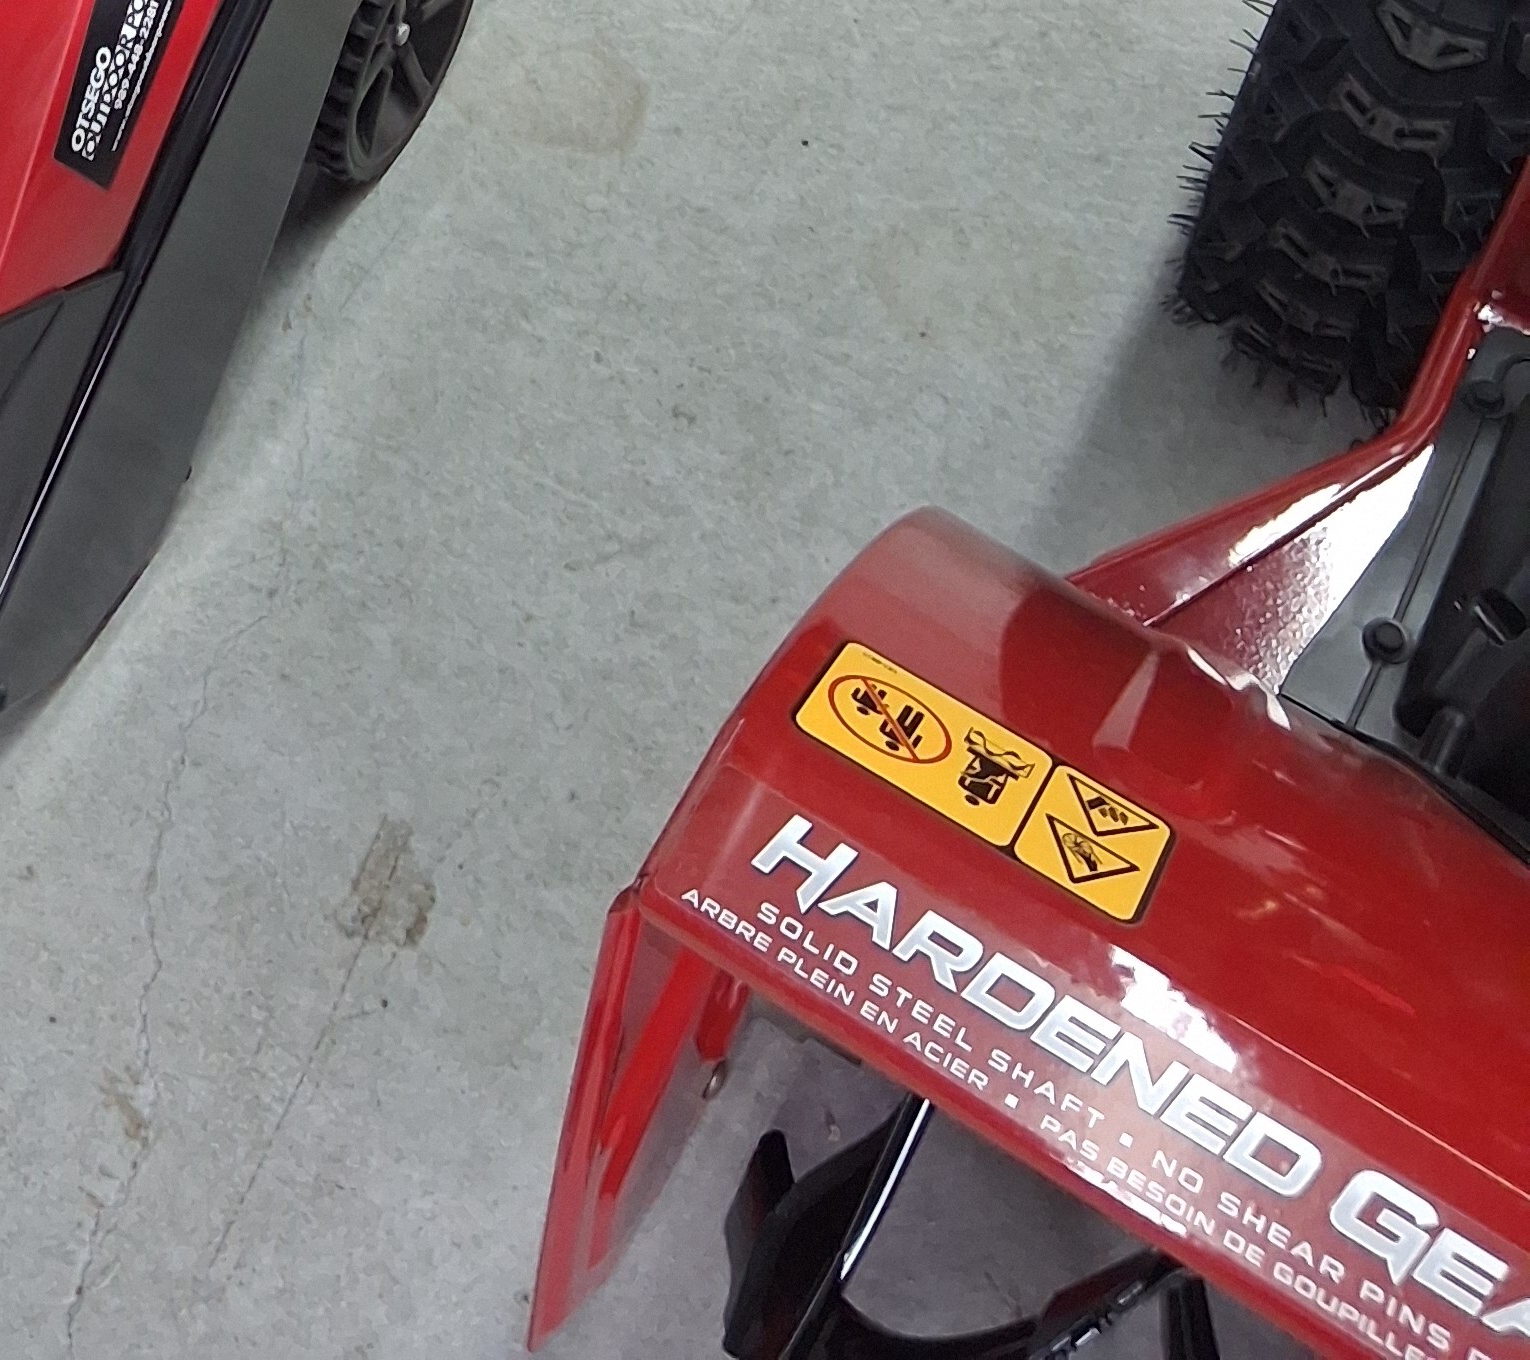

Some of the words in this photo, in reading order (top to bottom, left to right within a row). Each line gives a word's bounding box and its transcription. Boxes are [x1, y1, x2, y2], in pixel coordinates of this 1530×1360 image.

[71, 46, 112, 152] OTSEGO
[82, 31, 136, 161] OUTDOOR
[681, 888, 773, 953] ARBRE
[777, 947, 855, 1006] PLEIN
[860, 1000, 898, 1033] EN
[903, 1032, 989, 1091] ACIER
[1040, 1115, 1100, 1161] PAS
[1107, 1156, 1216, 1236] BESOIN
[1223, 1230, 1265, 1268] DE
[1273, 1261, 1436, 1360] GOUPILLE
[750, 813, 1322, 1198] HARDENED
[757, 901, 858, 976] SOLID
[869, 973, 972, 1052] STEEL
[988, 1048, 1105, 1129] SHAFT
[1152, 1150, 1204, 1193] NO
[1217, 1191, 1346, 1284] SHEAR
[1359, 1280, 1451, 1353] PINS
